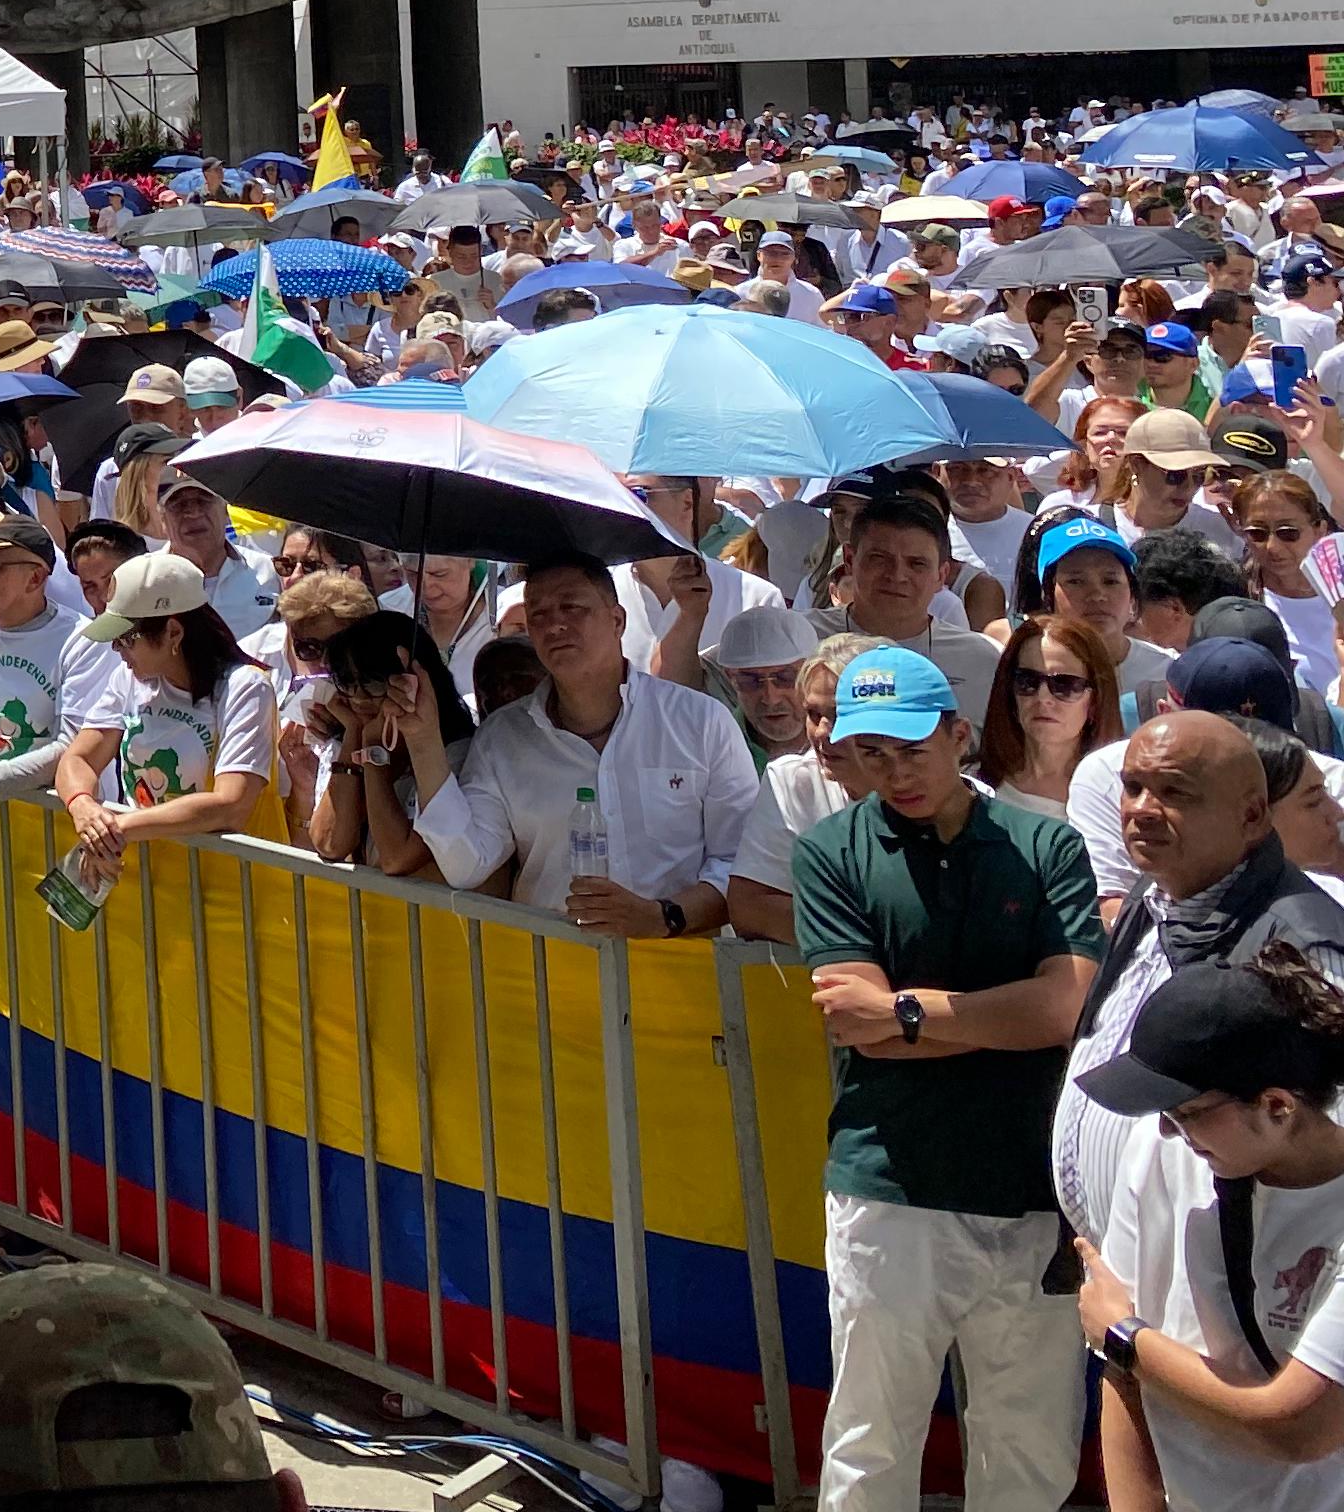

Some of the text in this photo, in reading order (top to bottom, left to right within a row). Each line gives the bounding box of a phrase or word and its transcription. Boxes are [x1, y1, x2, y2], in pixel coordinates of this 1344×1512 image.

[627, 11, 781, 28] ASAMBLEA DEPARTAMENTAL
[1173, 15, 1228, 26] OFICINA
[1231, 13, 1250, 24] DE
[698, 29, 713, 41] DE
[678, 43, 737, 56] ANTIOQUIA
[1066, 517, 1106, 537] alo
